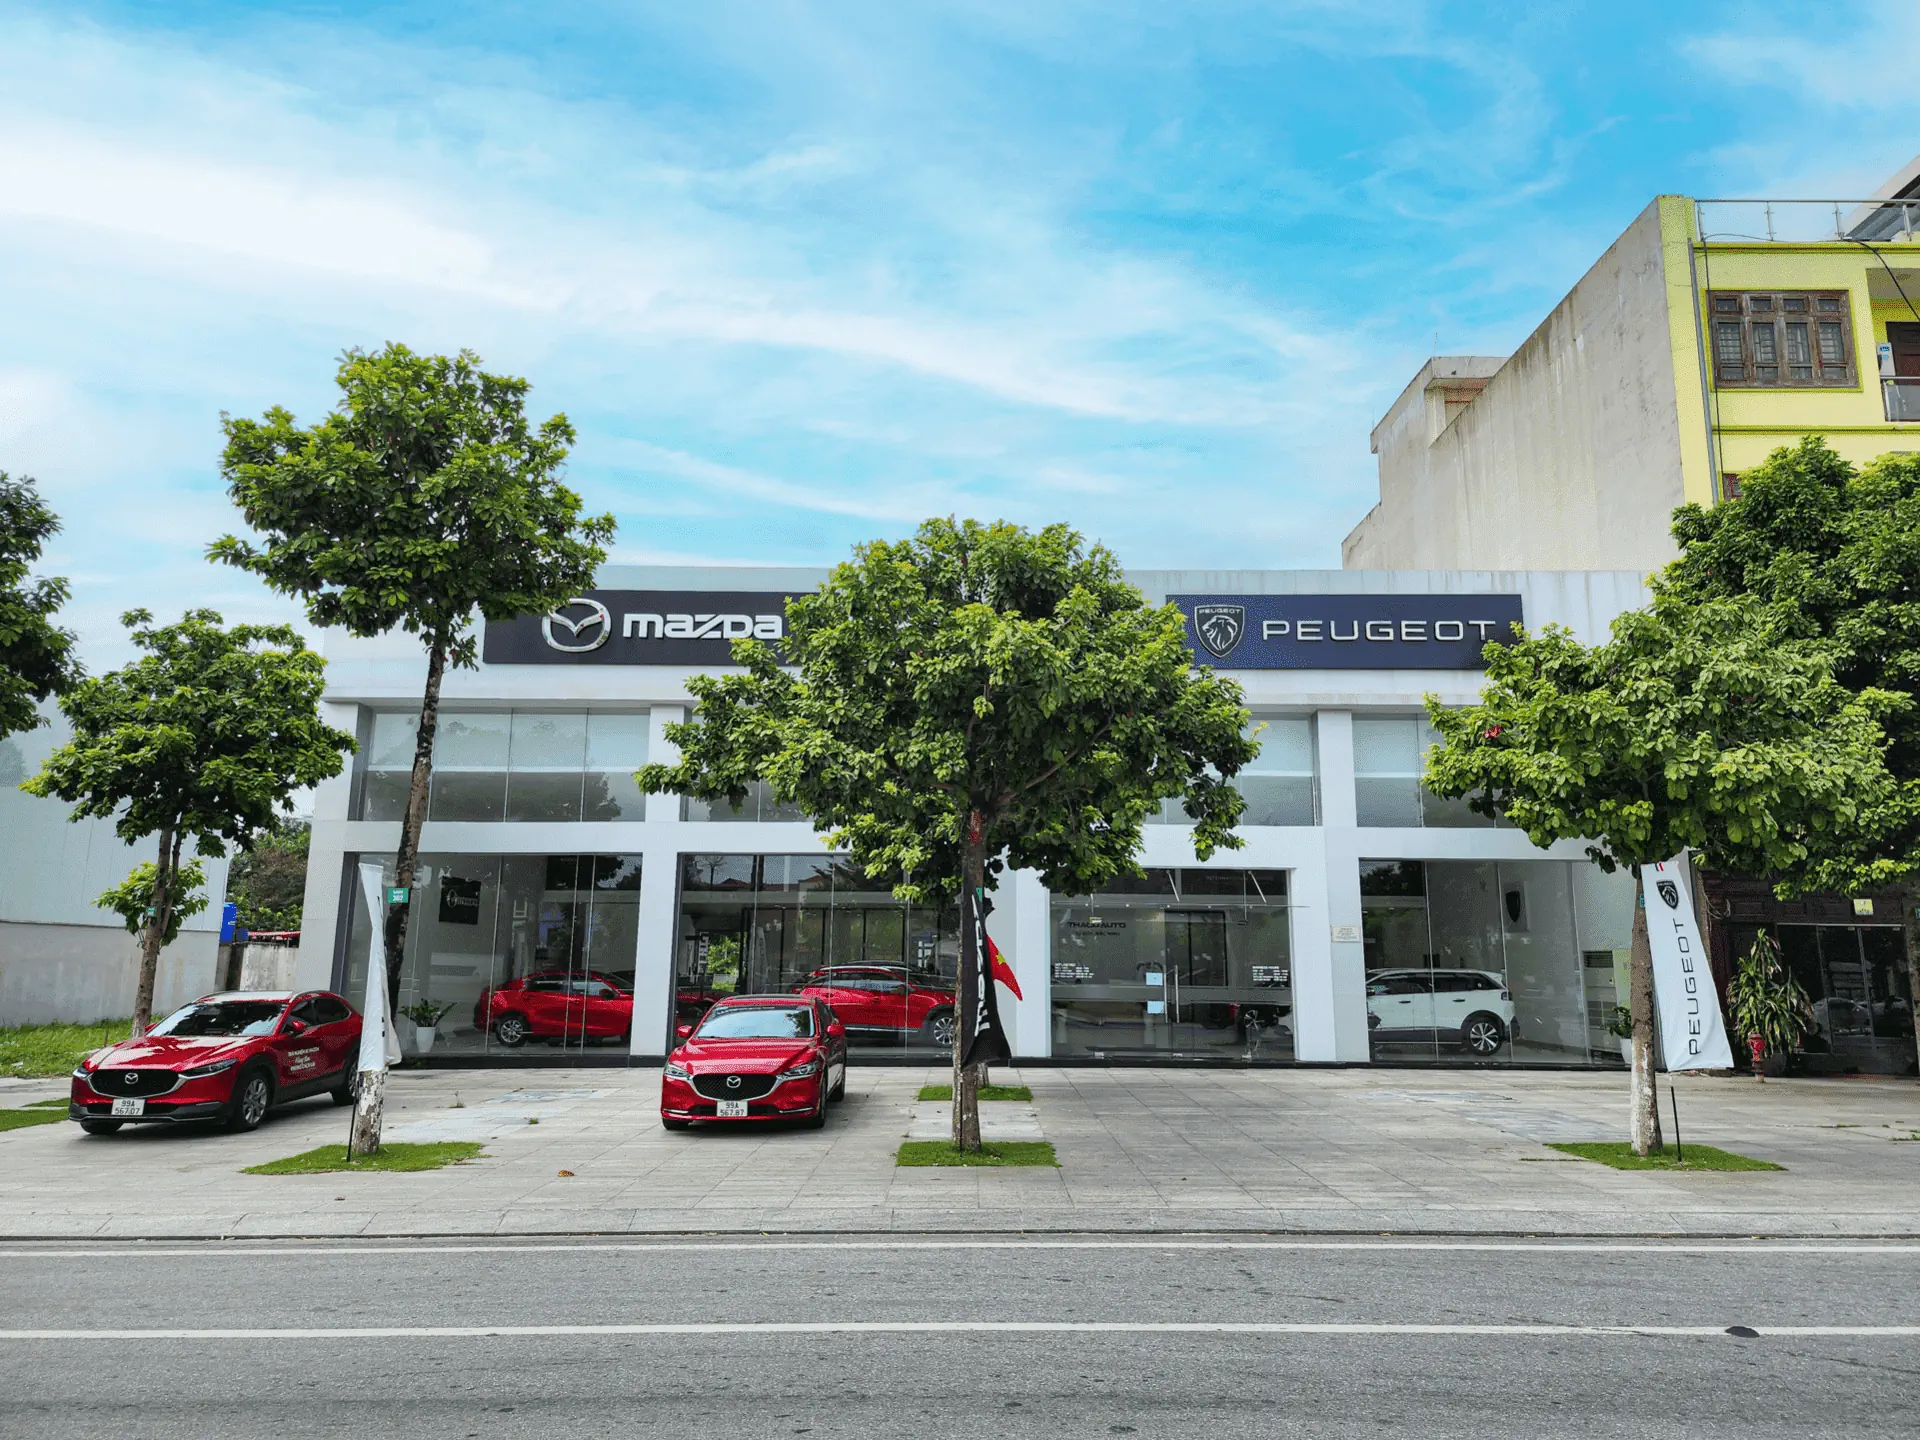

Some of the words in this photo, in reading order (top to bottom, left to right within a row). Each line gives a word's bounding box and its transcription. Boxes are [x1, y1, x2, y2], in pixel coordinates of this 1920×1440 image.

[1262, 620, 1496, 641] PEUGEOT
[1673, 917, 1702, 1056] PEUGEOT
[725, 1101, 739, 1109] 99A
